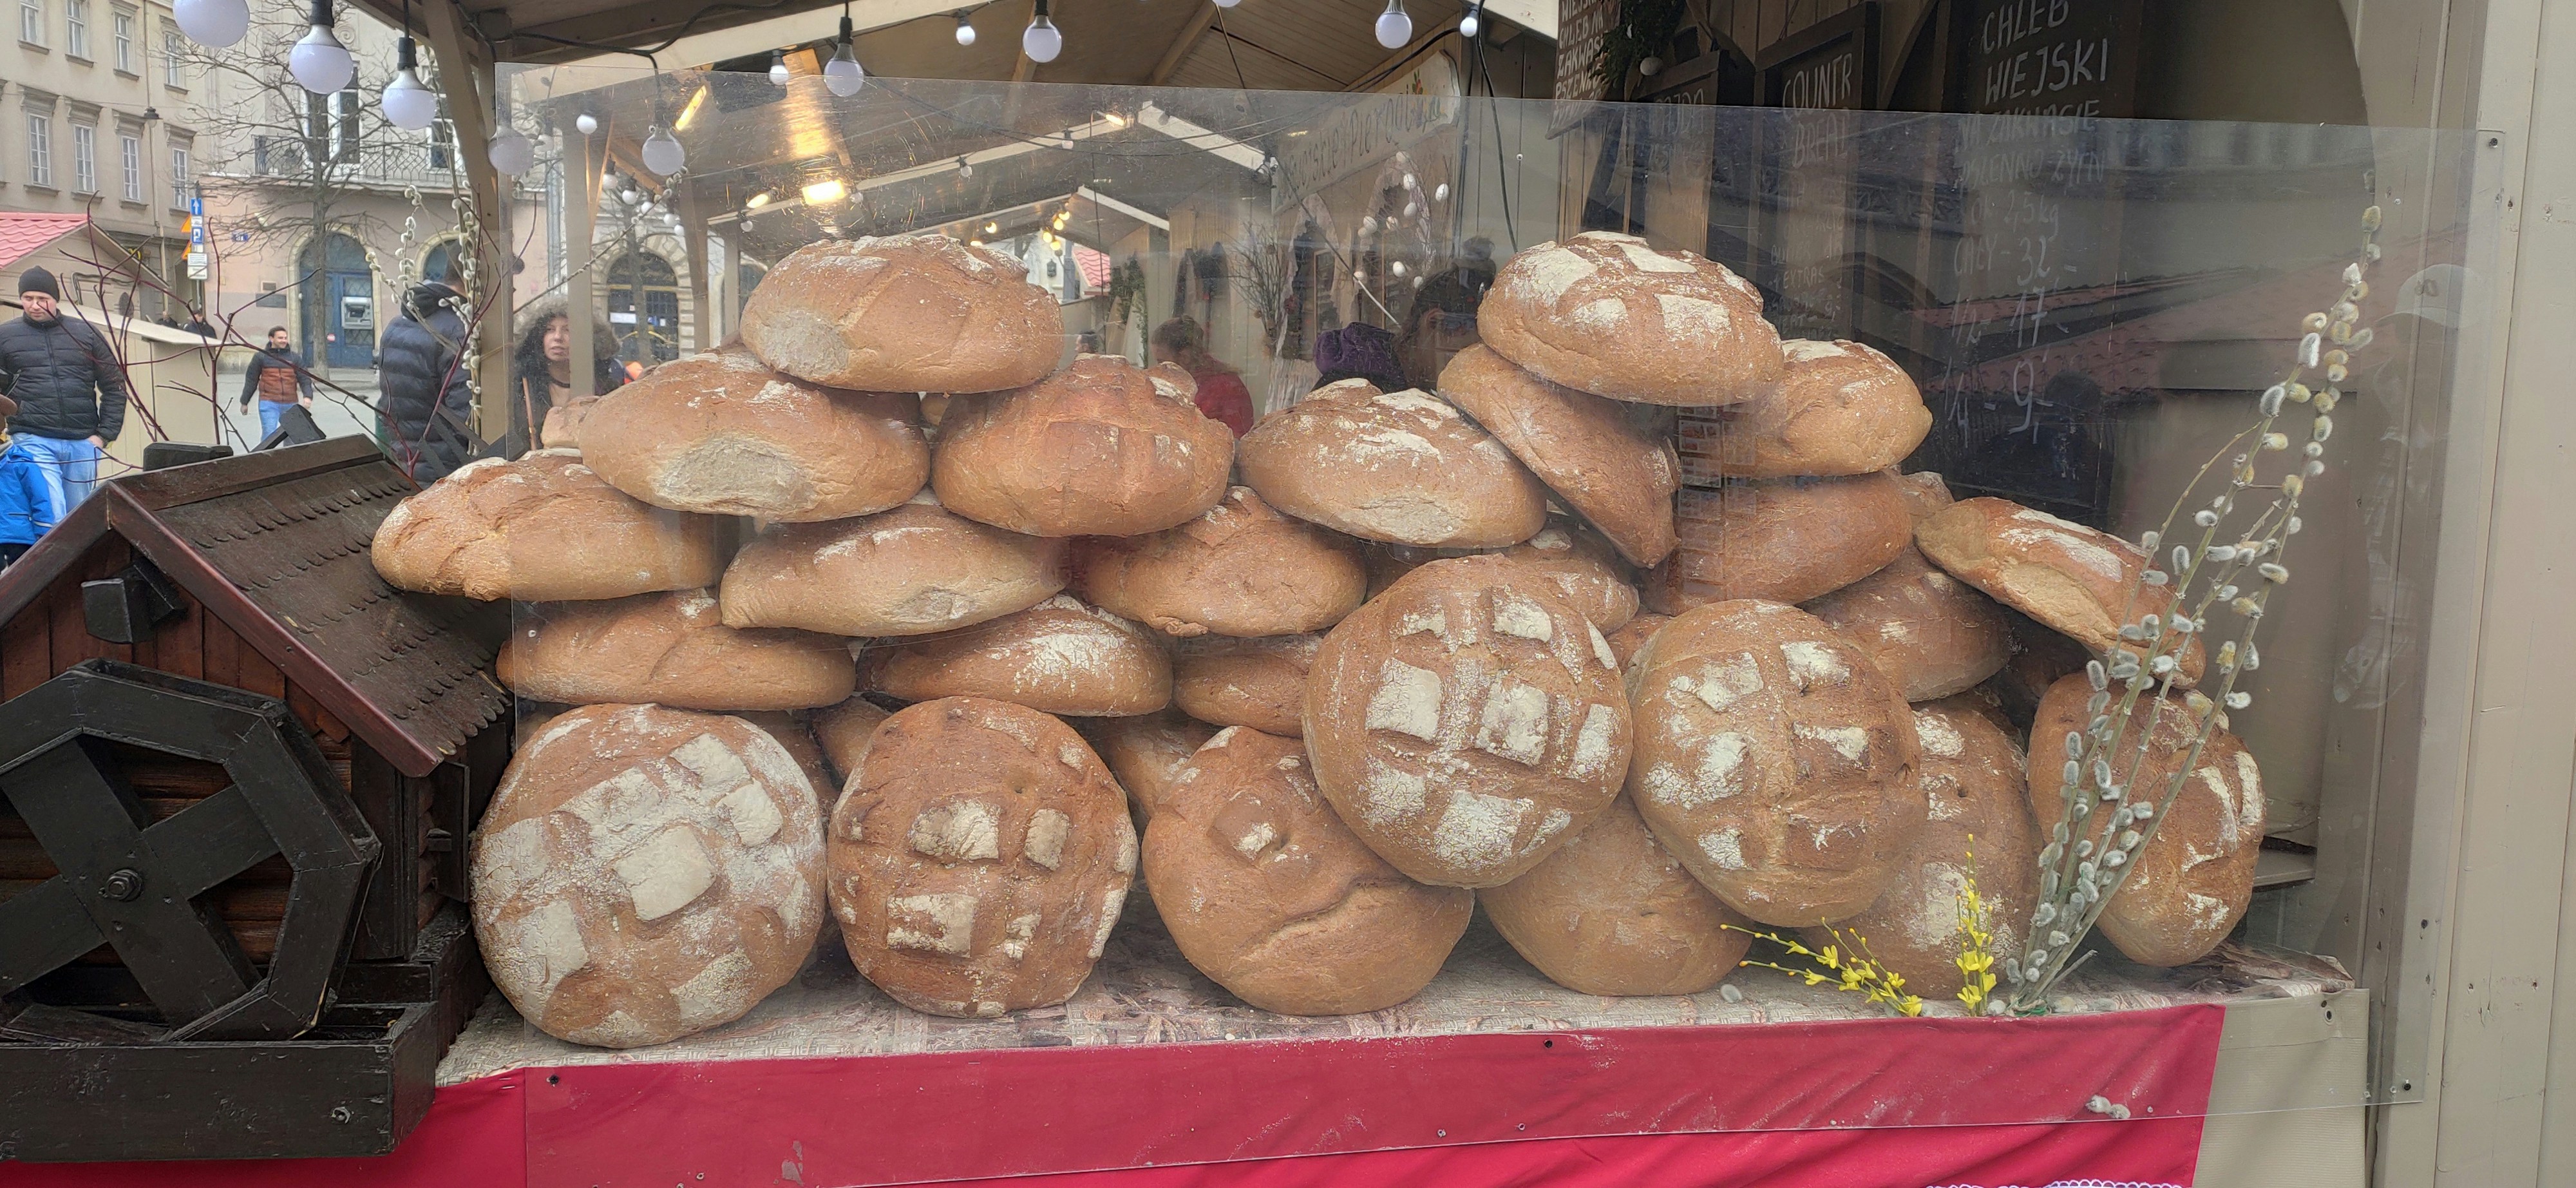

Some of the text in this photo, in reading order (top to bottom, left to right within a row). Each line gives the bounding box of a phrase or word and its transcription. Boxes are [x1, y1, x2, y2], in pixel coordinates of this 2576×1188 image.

[1559, 5, 1604, 49] CHLEB NA
[1981, 0, 2069, 54] CHLEB
[1985, 38, 2107, 106] WIEJSKI
[1783, 265, 1824, 289] EXTRAS
